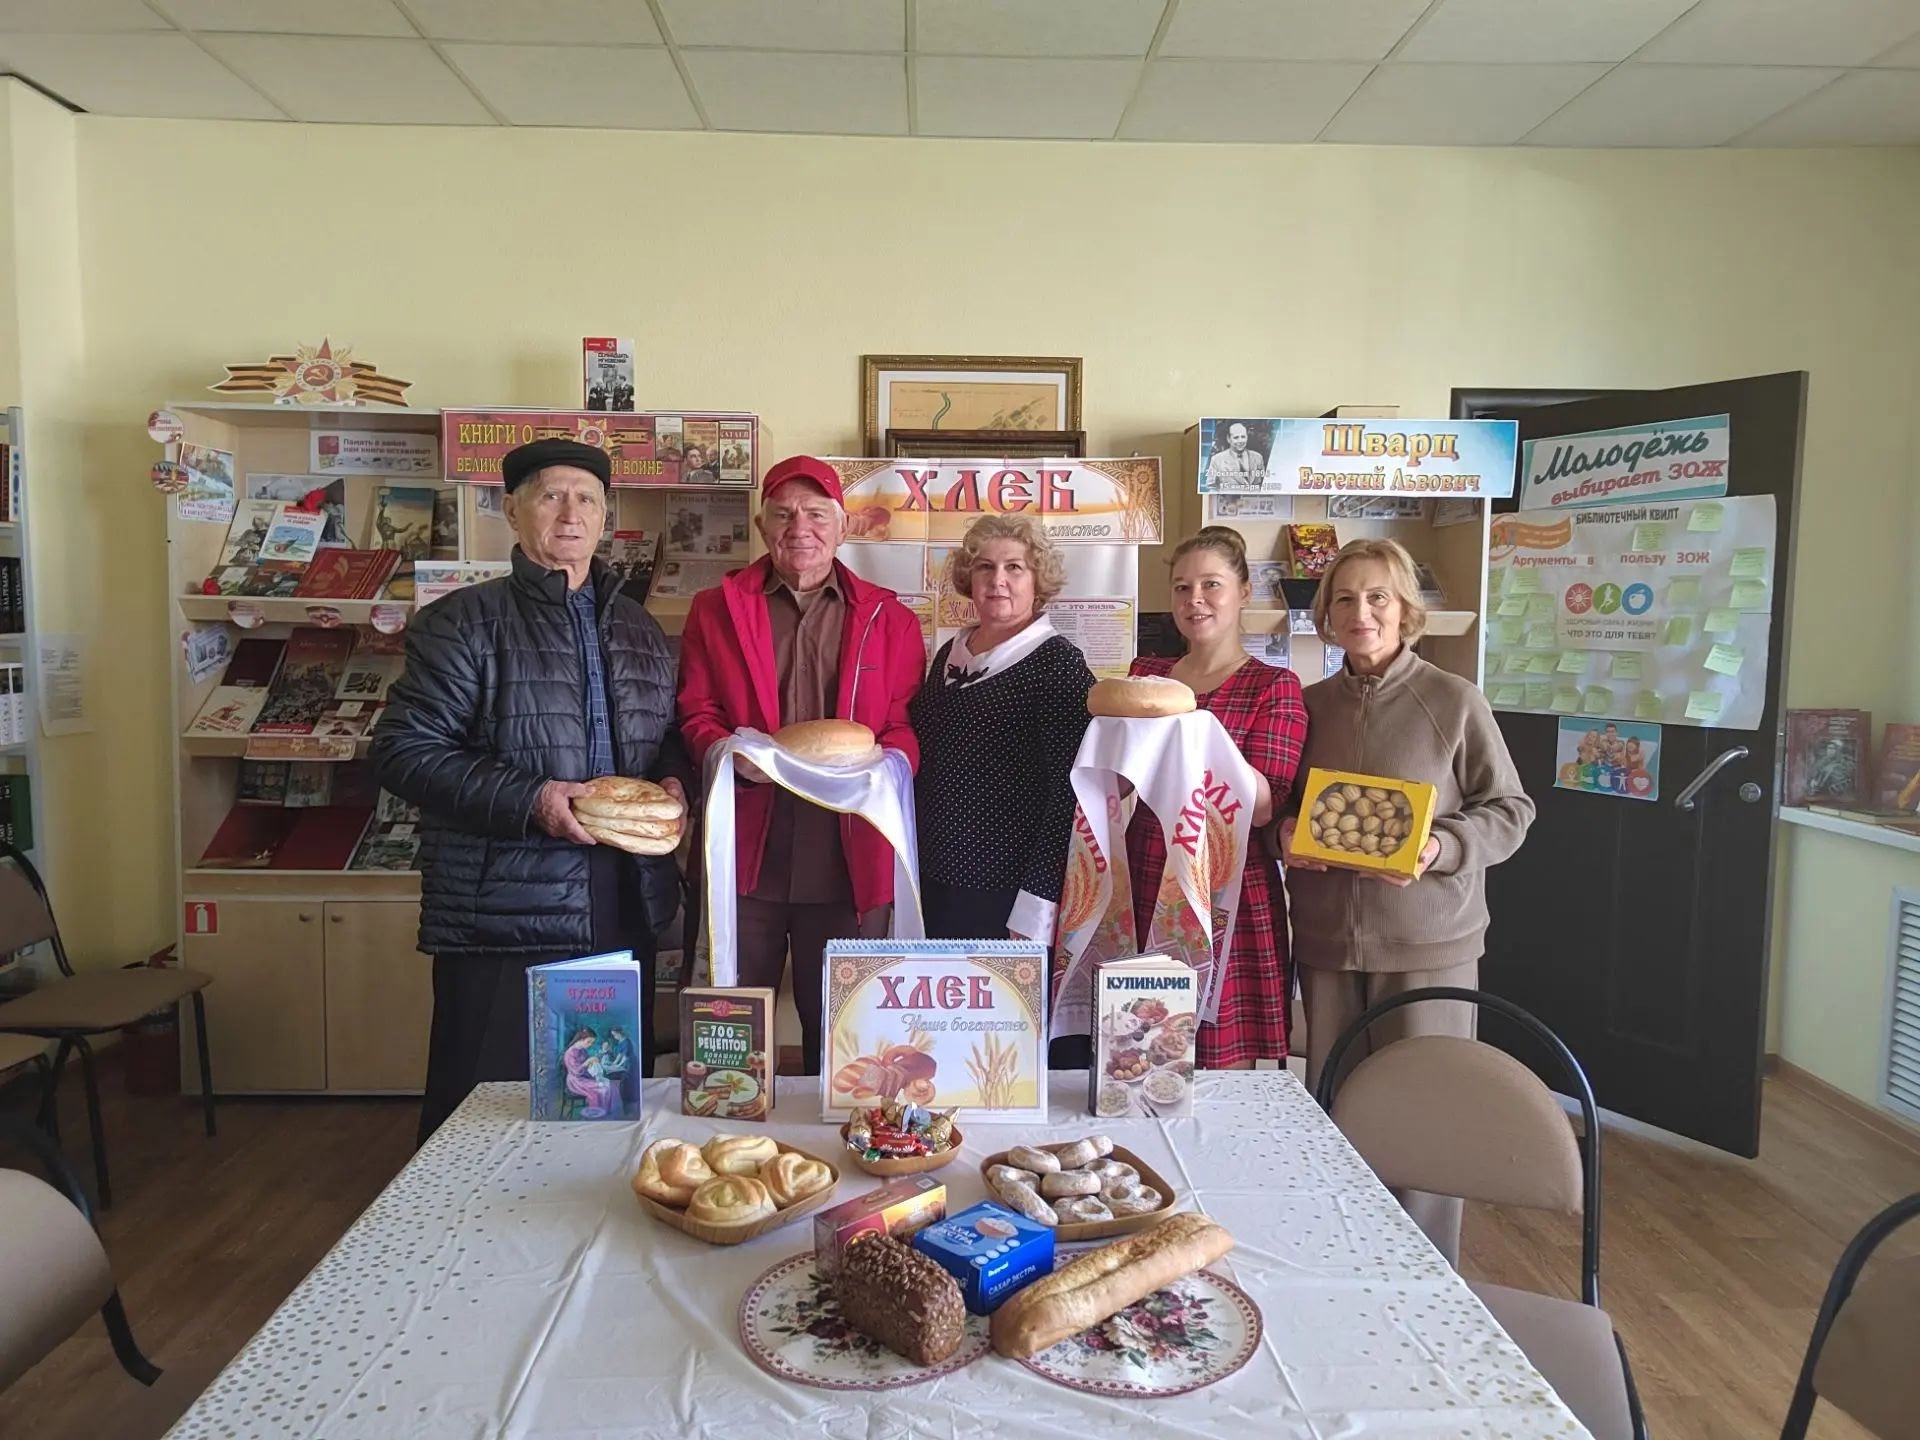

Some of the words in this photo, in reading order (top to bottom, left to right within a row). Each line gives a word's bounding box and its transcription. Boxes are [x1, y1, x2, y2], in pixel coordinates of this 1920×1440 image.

[459, 423, 516, 444] КНИГИ
[522, 425, 533, 444] О
[1322, 424, 1461, 467] Шварц
[457, 457, 504, 473] ВЕЛИКО
[623, 457, 663, 475] ВОЙНЕ
[1533, 428, 1710, 486] Молодёжь
[1298, 466, 1385, 491] Евгений
[1390, 468, 1482, 493] Львович
[1551, 469, 1662, 505] выбирает
[1668, 460, 1727, 481] ЗОЖ
[894, 470, 1079, 513] ХЛЕБ
[1576, 509, 1647, 525] БИБЛИОТЕЧНЫЙ
[1649, 507, 1679, 521] КВИЛТ
[1513, 556, 1577, 568] Аргументы
[1620, 554, 1666, 567] пользу
[1677, 551, 1711, 564] ЗОЖ
[1567, 629, 1583, 638] ЧТО
[1585, 630, 1603, 639] ЭТО
[1604, 631, 1624, 640] ДЛЯ
[1106, 976, 1191, 990] КУЛИНАРИЯ
[567, 986, 616, 1001] ЧУЖОЙ
[876, 976, 995, 1010] ХЛЕБ
[575, 1002, 608, 1014] ХЛЕБ
[710, 1025, 735, 1039] 700
[901, 1014, 947, 1033] Наше
[950, 1017, 1029, 1033] богатство
[697, 1037, 747, 1052] РЕЦЕПТОВ
[704, 1052, 742, 1060] ДОМАШНЕЙ
[932, 1227, 975, 1246] ЭКСТРА
[942, 1222, 978, 1239] САХАР
[988, 1277, 1012, 1296] САХАР
[1011, 1265, 1037, 1285] ЭКСТРА
